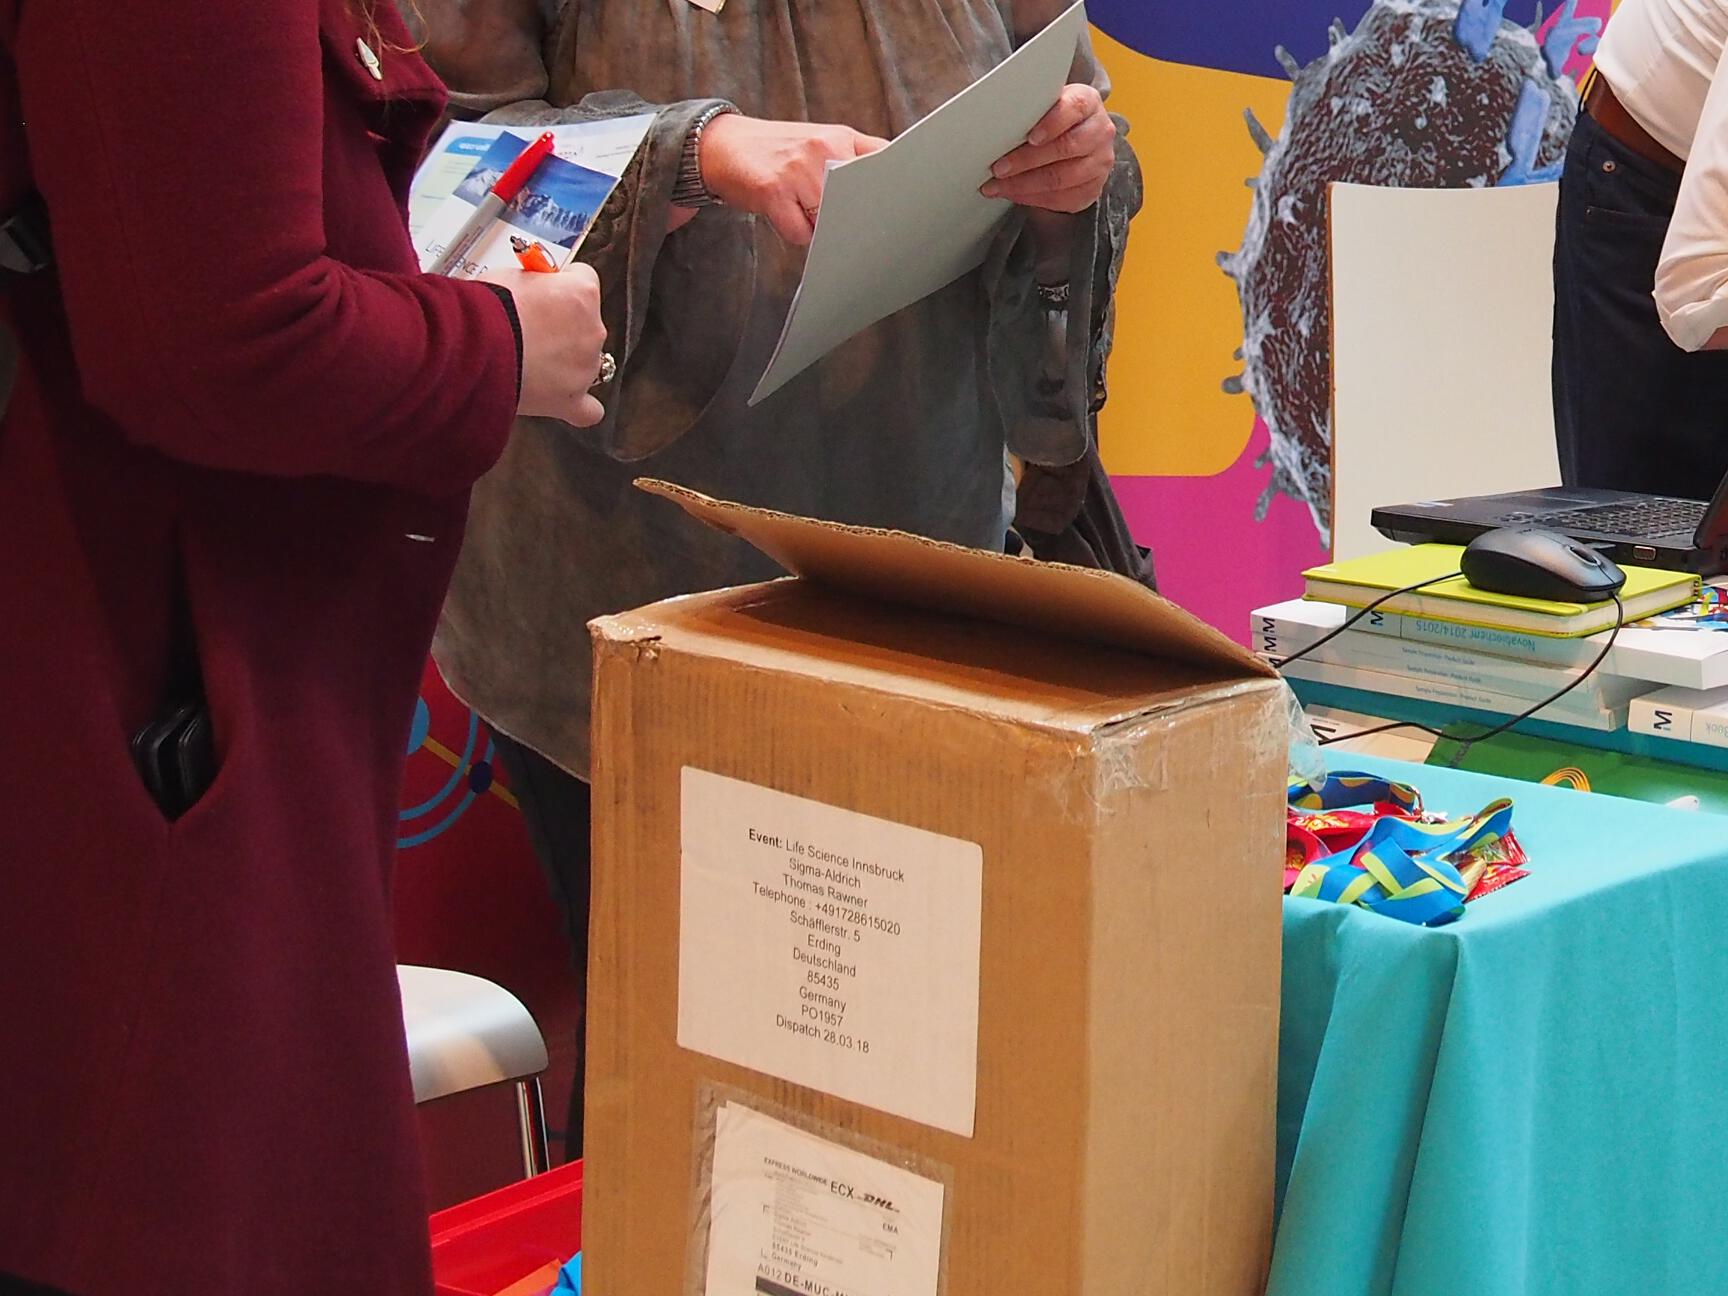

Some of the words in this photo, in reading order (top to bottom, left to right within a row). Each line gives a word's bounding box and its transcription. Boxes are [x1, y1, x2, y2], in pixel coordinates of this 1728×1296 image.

[749, 828, 783, 849] Event:
[786, 837, 805, 855] Life
[807, 845, 849, 868] Science
[852, 857, 905, 882] Innsbruck
[789, 857, 861, 889] Sigma-Aldrich
[782, 873, 825, 896] Thomas
[827, 886, 869, 908] Rawner
[752, 881, 806, 909] Telephone
[815, 903, 901, 936] +491728615020
[807, 934, 841, 958] Erding
[853, 930, 861, 943] 5
[793, 947, 857, 977] Deutschland
[807, 969, 840, 991] 85435
[799, 985, 847, 1014] Germany
[801, 1004, 843, 1027] PO1957
[776, 1014, 821, 1039] Dispatch
[823, 1029, 870, 1054] 28.03.18
[830, 1180, 855, 1200] ECX
[863, 1193, 900, 1213] DHL
[771, 1253, 802, 1273] Germany
